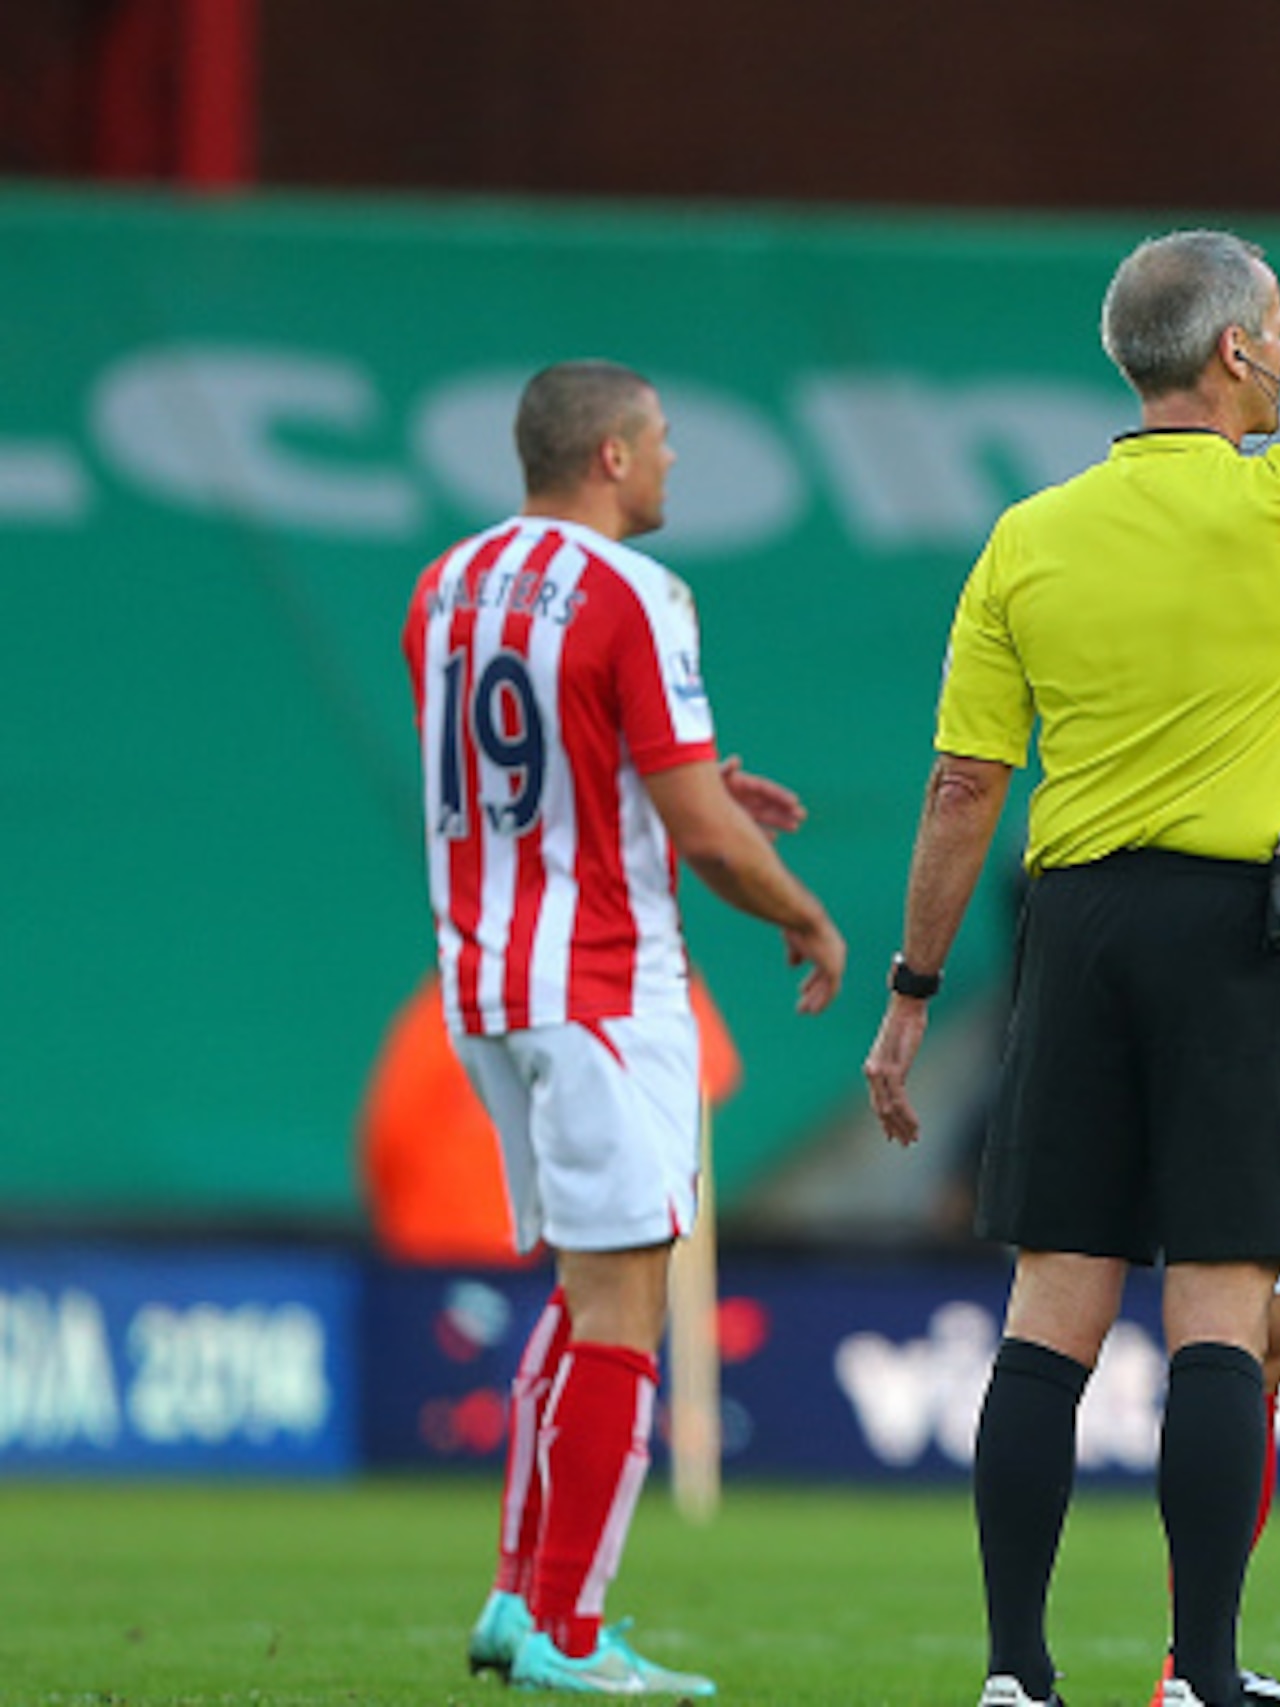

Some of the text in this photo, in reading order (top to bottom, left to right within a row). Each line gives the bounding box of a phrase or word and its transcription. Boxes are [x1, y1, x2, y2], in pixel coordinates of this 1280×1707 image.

[425, 570, 588, 627] WALTERS
[436, 648, 547, 838] 19
[127, 1302, 328, 1444] 2014
